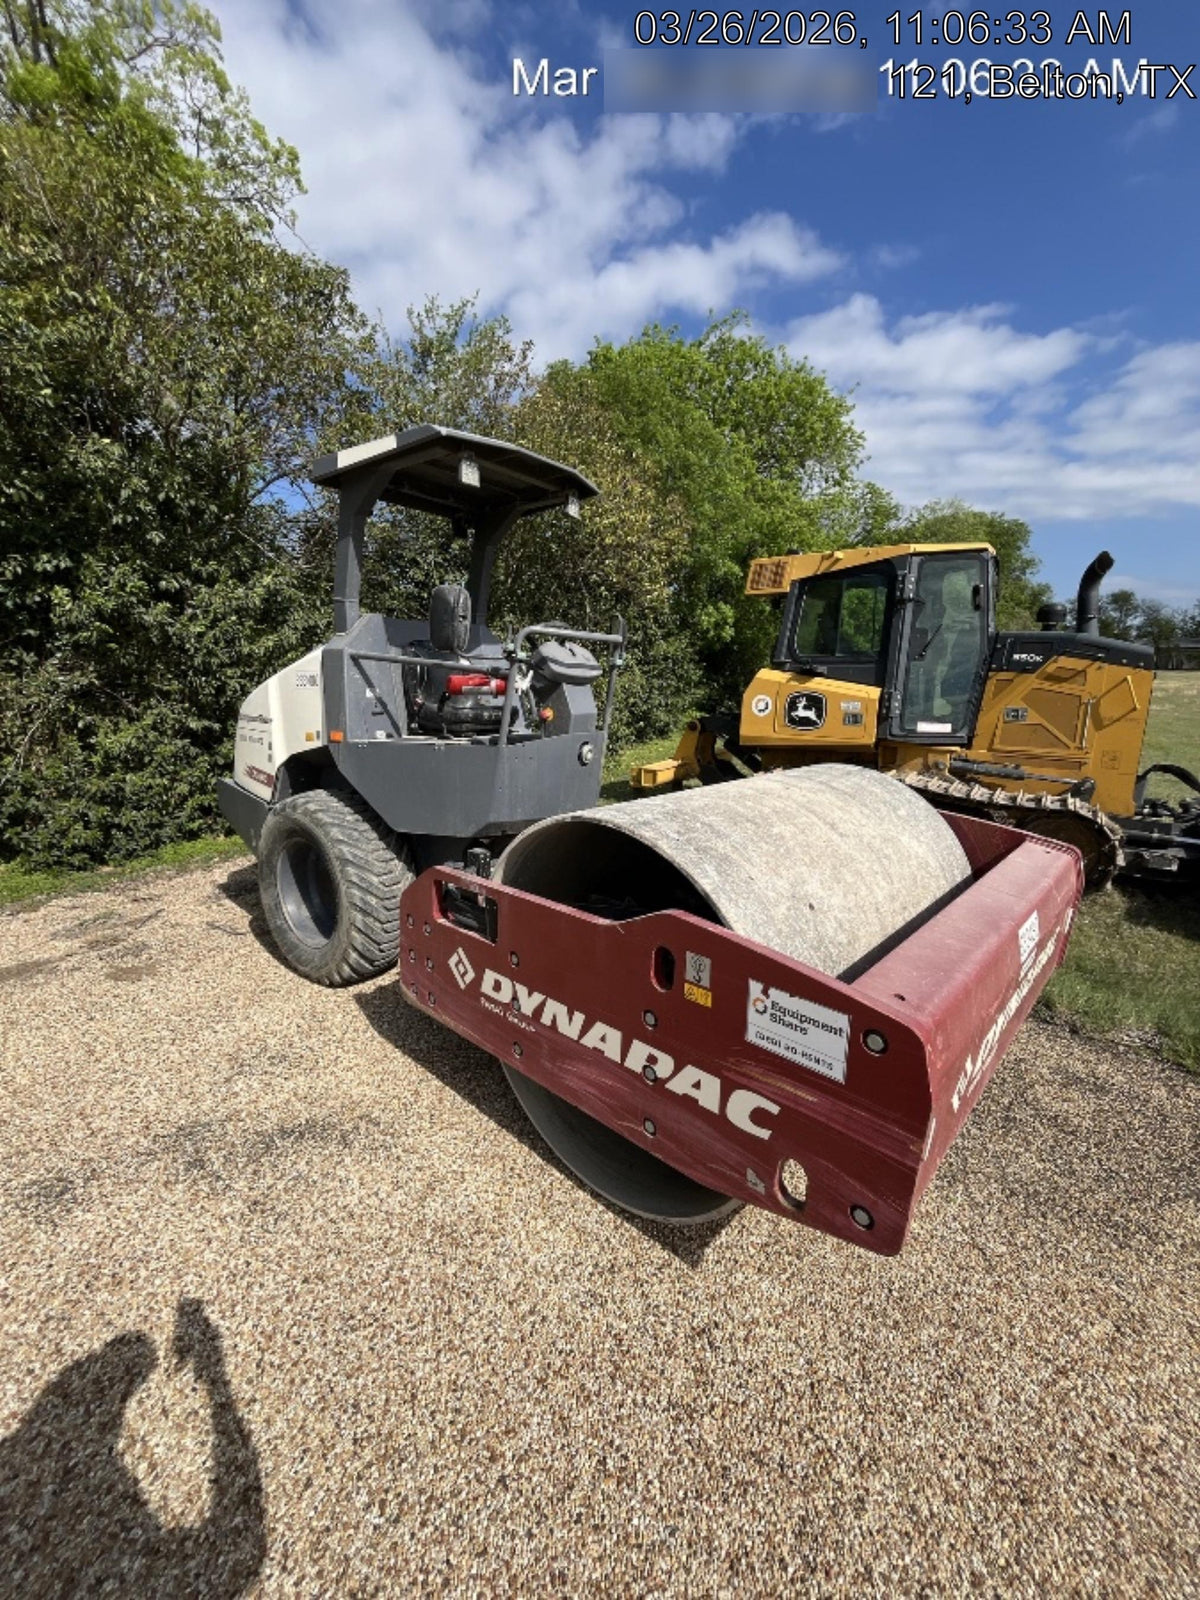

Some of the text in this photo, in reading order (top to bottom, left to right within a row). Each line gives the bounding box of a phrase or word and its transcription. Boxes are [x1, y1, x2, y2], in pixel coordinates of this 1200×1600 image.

[769, 1000, 846, 1038] Equipment
[769, 1012, 809, 1036] Share
[480, 968, 782, 1141] DYNAPAC
